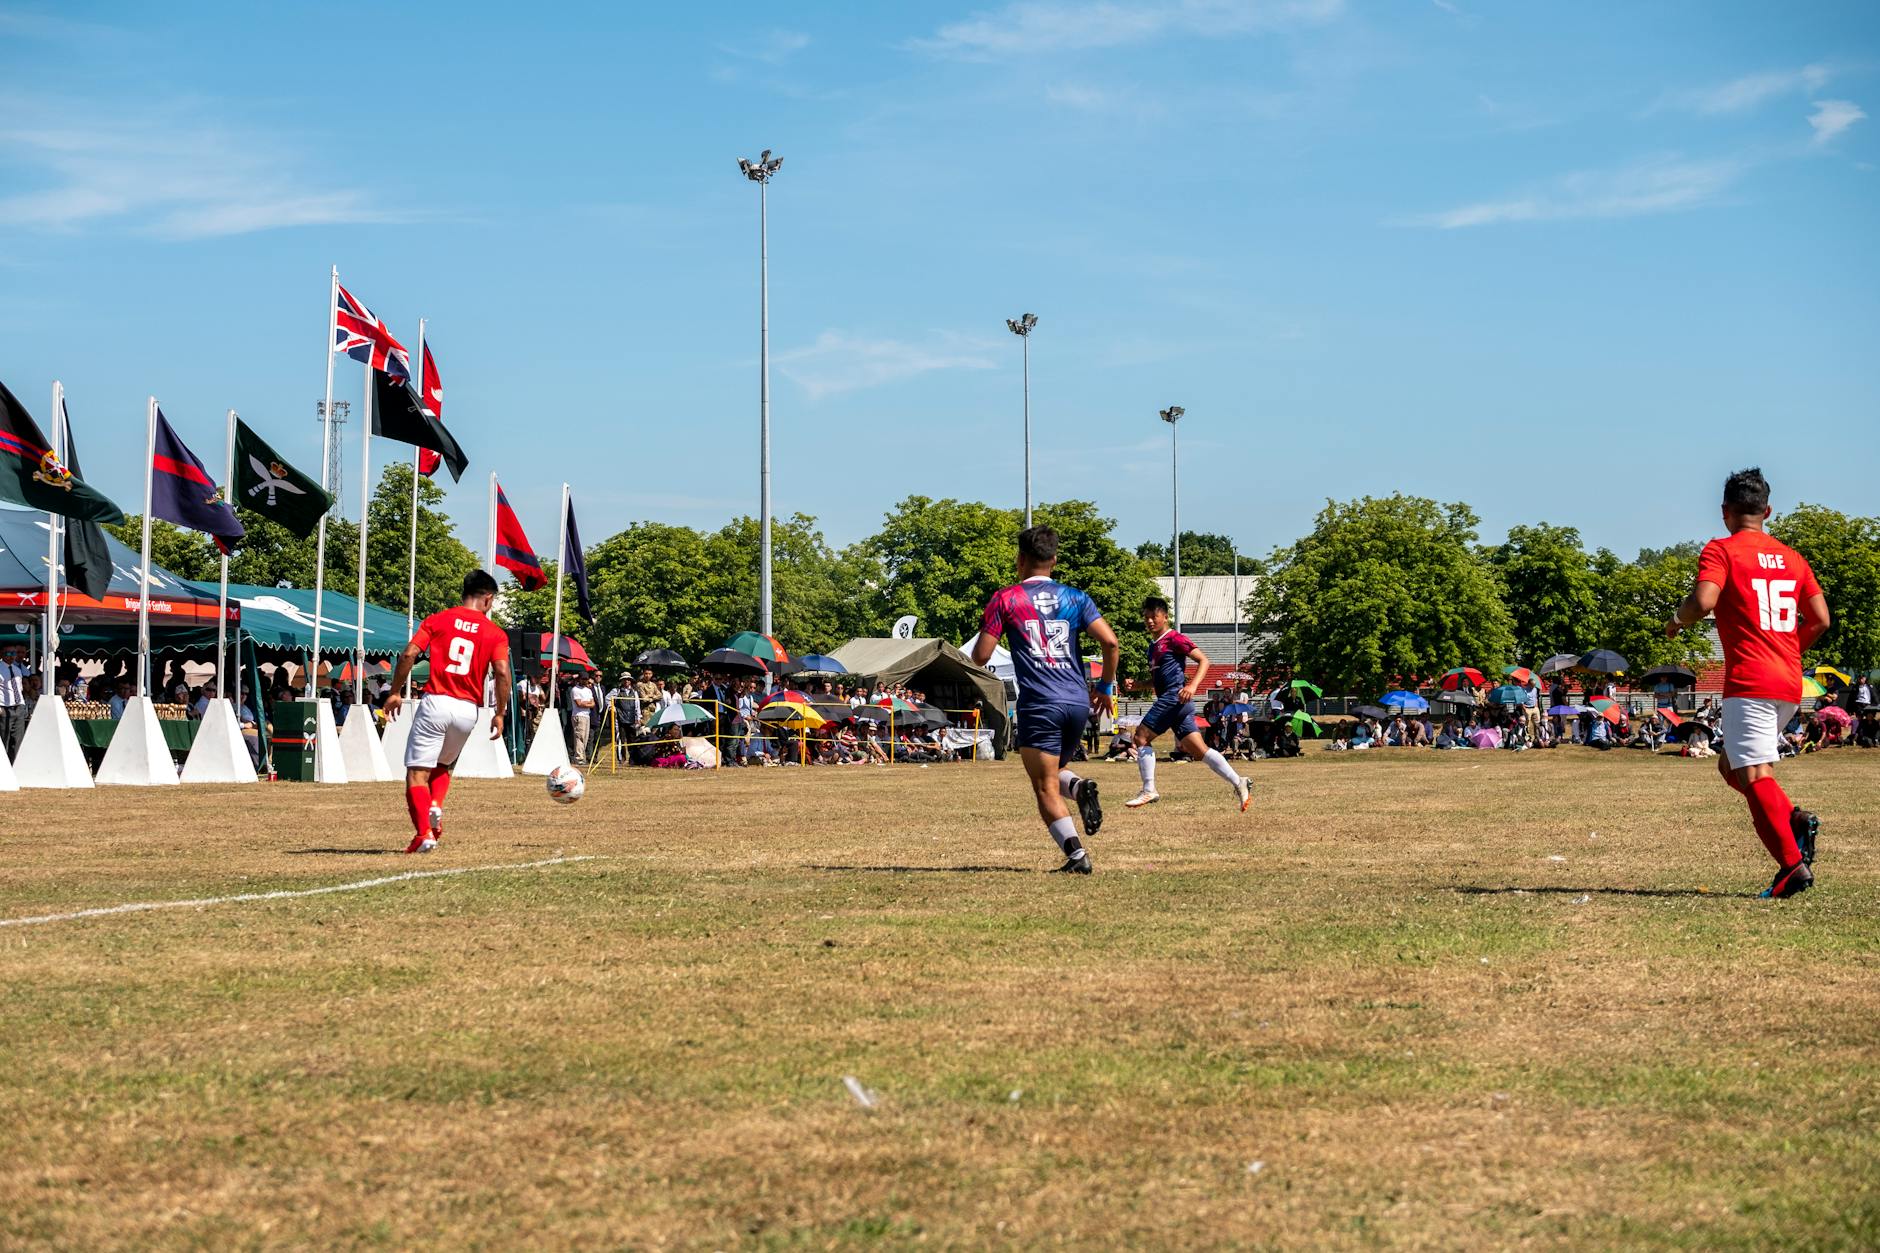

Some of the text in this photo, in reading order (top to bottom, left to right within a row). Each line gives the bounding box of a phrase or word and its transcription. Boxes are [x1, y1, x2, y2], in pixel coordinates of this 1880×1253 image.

[1757, 552, 1786, 570] QGE
[1751, 578, 1797, 633] 16
[454, 618, 480, 634] QGE
[1024, 619, 1071, 658] 12
[445, 636, 475, 676] 9
